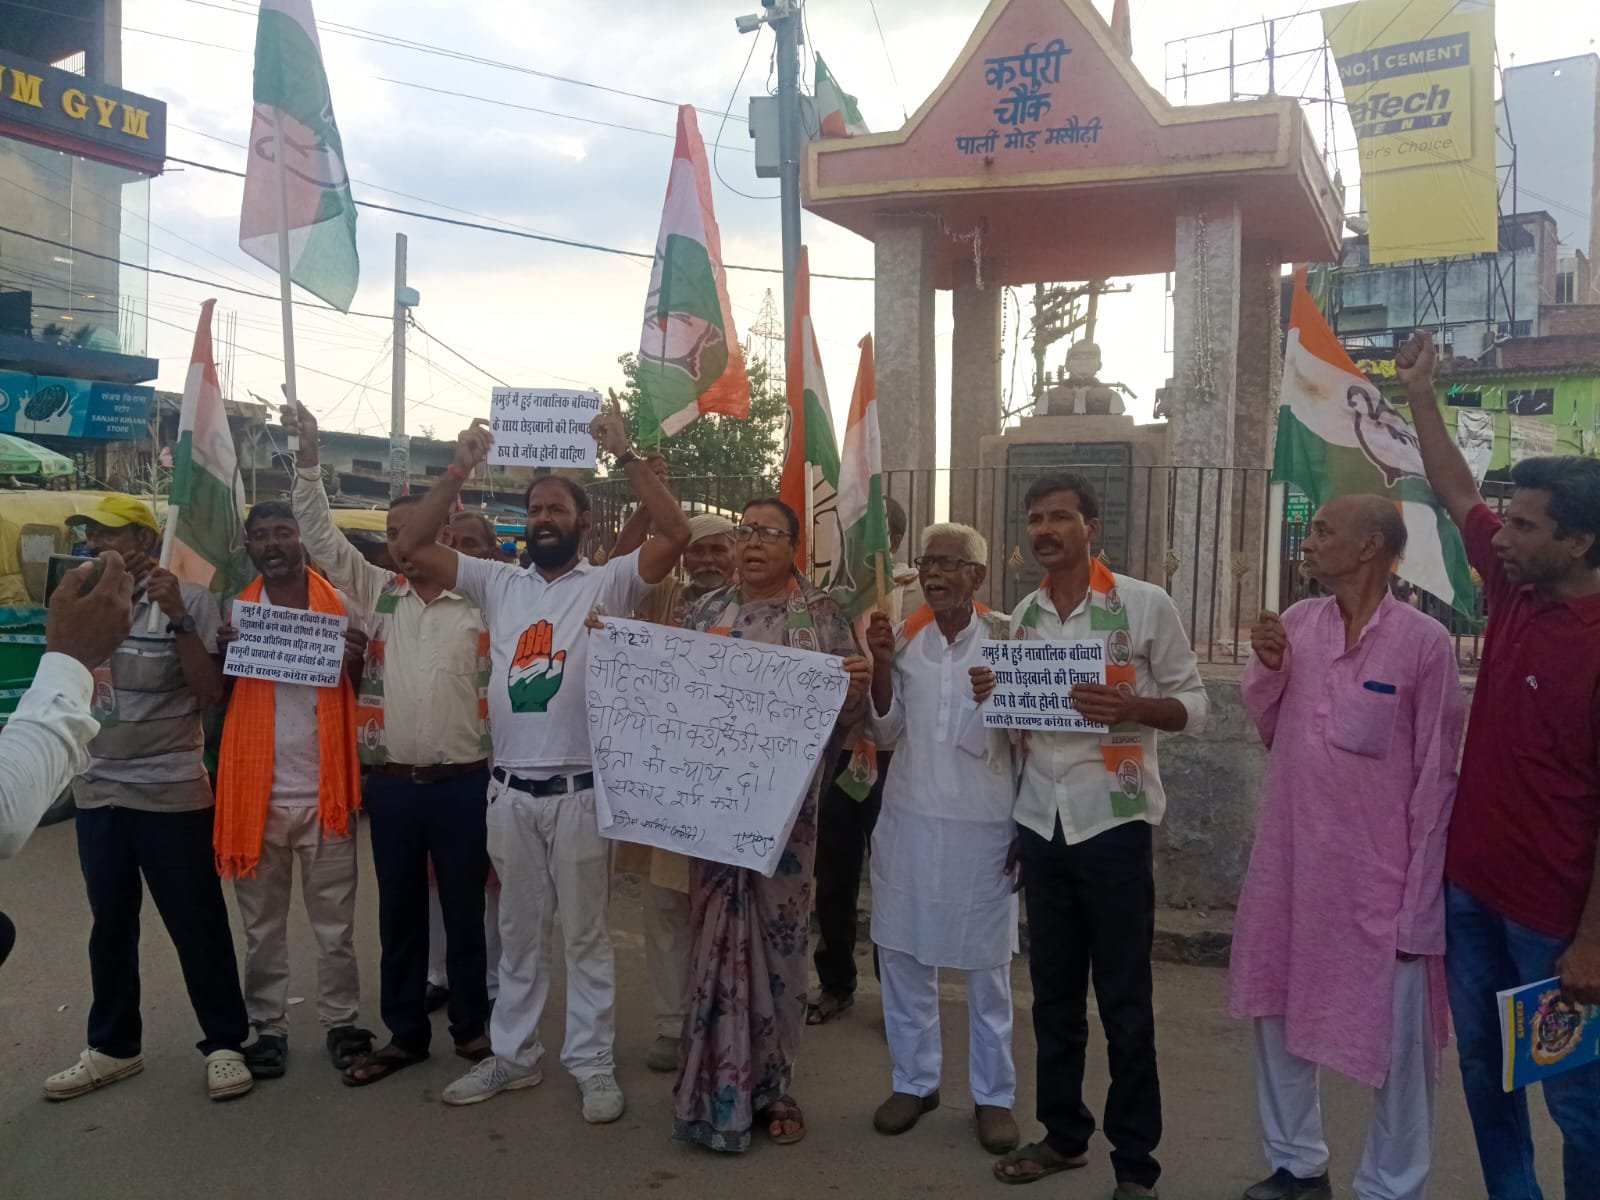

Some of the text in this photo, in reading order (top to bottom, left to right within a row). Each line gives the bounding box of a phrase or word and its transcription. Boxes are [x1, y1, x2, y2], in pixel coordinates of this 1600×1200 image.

[1385, 43, 1464, 69] CEMENT
[61, 88, 150, 139] GYM
[955, 128, 1001, 155] पाली
[1003, 128, 1042, 153] मोड़
[1398, 138, 1453, 156] Choice
[521, 393, 532, 411] हुई
[533, 393, 570, 408] नाबालिक
[91, 414, 119, 423] SANJAY
[492, 417, 500, 431] के
[502, 419, 519, 432] साथ
[520, 417, 553, 435] छेड़खानी
[555, 419, 567, 434] की
[106, 425, 129, 433] STORE
[497, 445, 511, 458] रूप
[512, 443, 519, 458] से
[539, 444, 558, 462] होनी
[240, 633, 262, 643] POCSO
[981, 644, 999, 665] जमुई
[1001, 644, 1009, 660] में
[1011, 644, 1023, 666] हुई
[1024, 644, 1067, 661] नाबालिक
[1053, 668, 1067, 685] की
[993, 694, 1006, 707] रूप
[1008, 691, 1016, 708] से
[1038, 692, 1059, 711] होनी
[1044, 715, 1072, 728] कांग्रेस
